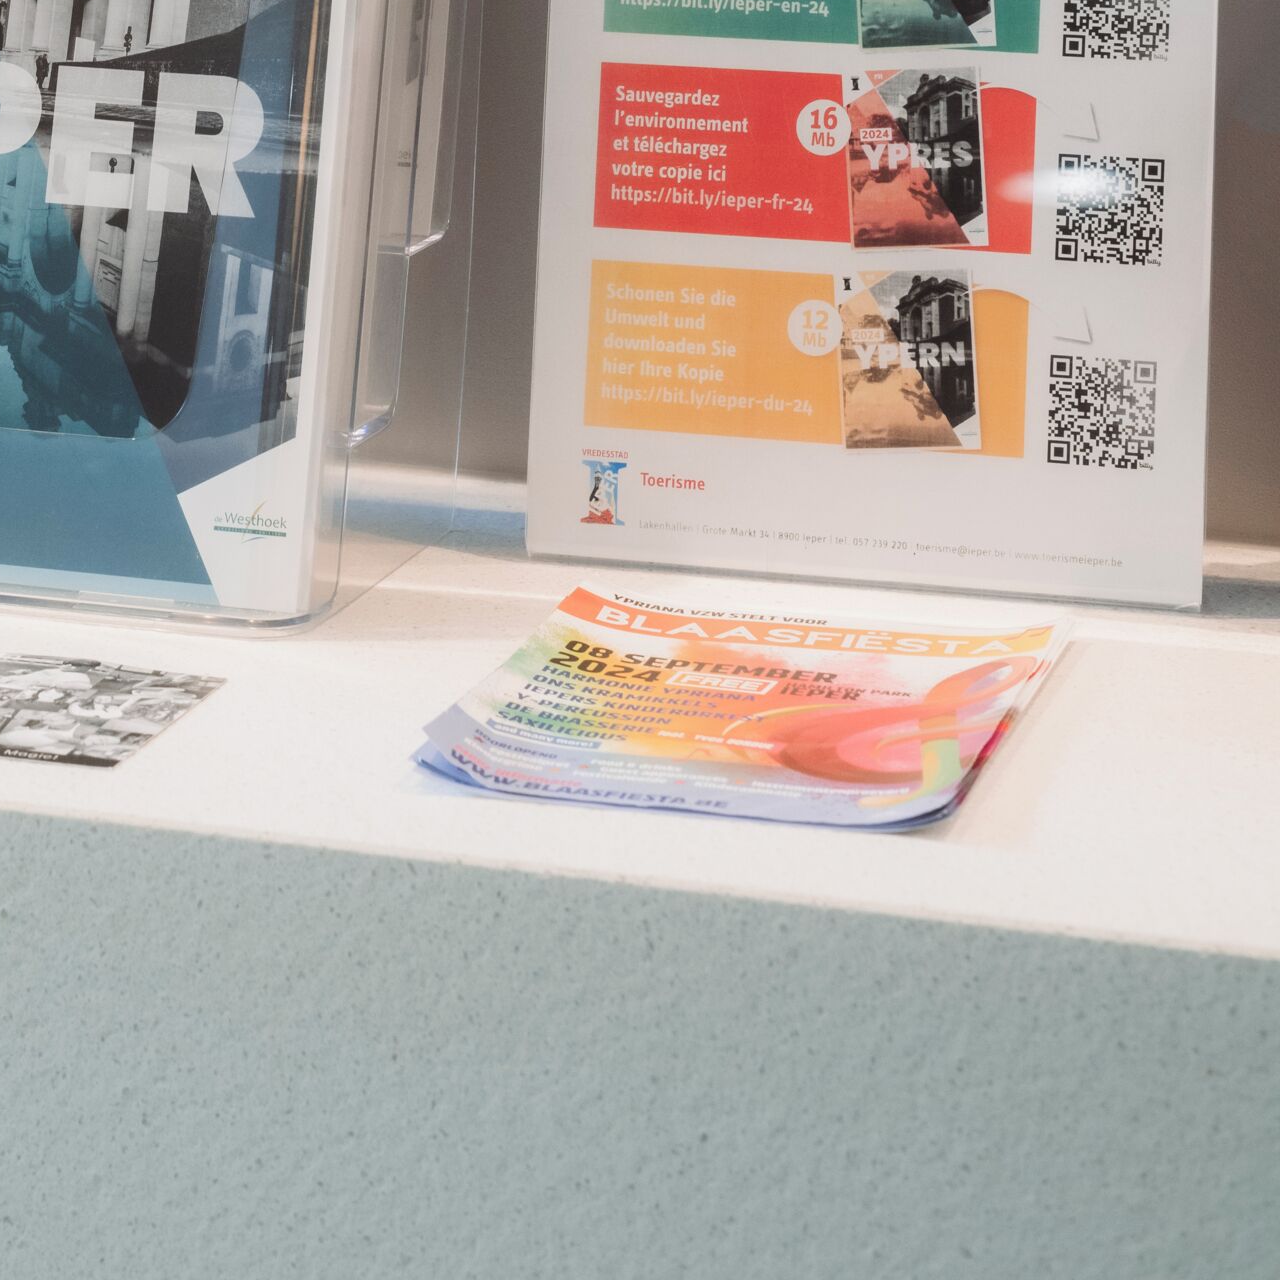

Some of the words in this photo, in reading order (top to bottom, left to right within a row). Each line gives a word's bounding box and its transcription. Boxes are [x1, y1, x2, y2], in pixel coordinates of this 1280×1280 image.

[616, 86, 720, 108] Sauvegardez
[811, 107, 838, 130] 16
[811, 132, 835, 147] Mb
[862, 130, 889, 139] 2024
[613, 137, 629, 151] et
[634, 136, 727, 160] téléchargez
[862, 140, 973, 170] YPRES
[612, 161, 654, 177] votre
[659, 162, 702, 183] copie
[708, 165, 726, 181] ici
[611, 184, 814, 214] https://bit.ly/ieper-fr-24
[606, 283, 675, 302] Schonen
[680, 288, 704, 304] Sie
[710, 290, 736, 307] die
[605, 309, 669, 327] Umwelt
[675, 313, 705, 330] und
[802, 310, 829, 330] 12
[603, 333, 704, 354] downloaden
[711, 341, 736, 357] Sie
[802, 332, 826, 348] Mb
[853, 331, 881, 339] 2024
[854, 341, 965, 368] YPERN
[602, 358, 634, 375] hier
[640, 360, 672, 377] Ihre
[678, 363, 724, 384] Kopie
[601, 384, 813, 415] https://bit.ly/ieper-du-24
[582, 448, 629, 459] VREDESSTAD
[640, 472, 705, 490] Toerisme
[225, 512, 286, 528] Westhoek
[703, 525, 727, 536] Grote
[731, 526, 756, 538] Markt
[759, 529, 769, 538] 34
[778, 531, 799, 541] 8900
[614, 594, 685, 614] YPRIANA
[729, 613, 775, 621] STELT
[783, 617, 828, 626] VOOR
[594, 604, 1015, 656] BLAASFIËSTA
[549, 652, 663, 683] 2024
[678, 676, 762, 691] FREE
[565, 640, 613, 659] 08
[620, 653, 838, 684] SEPTEMBER
[533, 674, 576, 690] ONS
[581, 685, 717, 709] KRAMIKKELS
[541, 664, 660, 692] HARMONIE
[662, 687, 757, 703] YPRIANA
[516, 692, 672, 725] V-PERCUSSION
[524, 683, 599, 706] IEPERS
[602, 699, 766, 723] KINDERORKEST
[497, 709, 628, 742] SAXILICIOUS
[505, 701, 534, 714] DE
[538, 710, 656, 735] BRASSERIE
